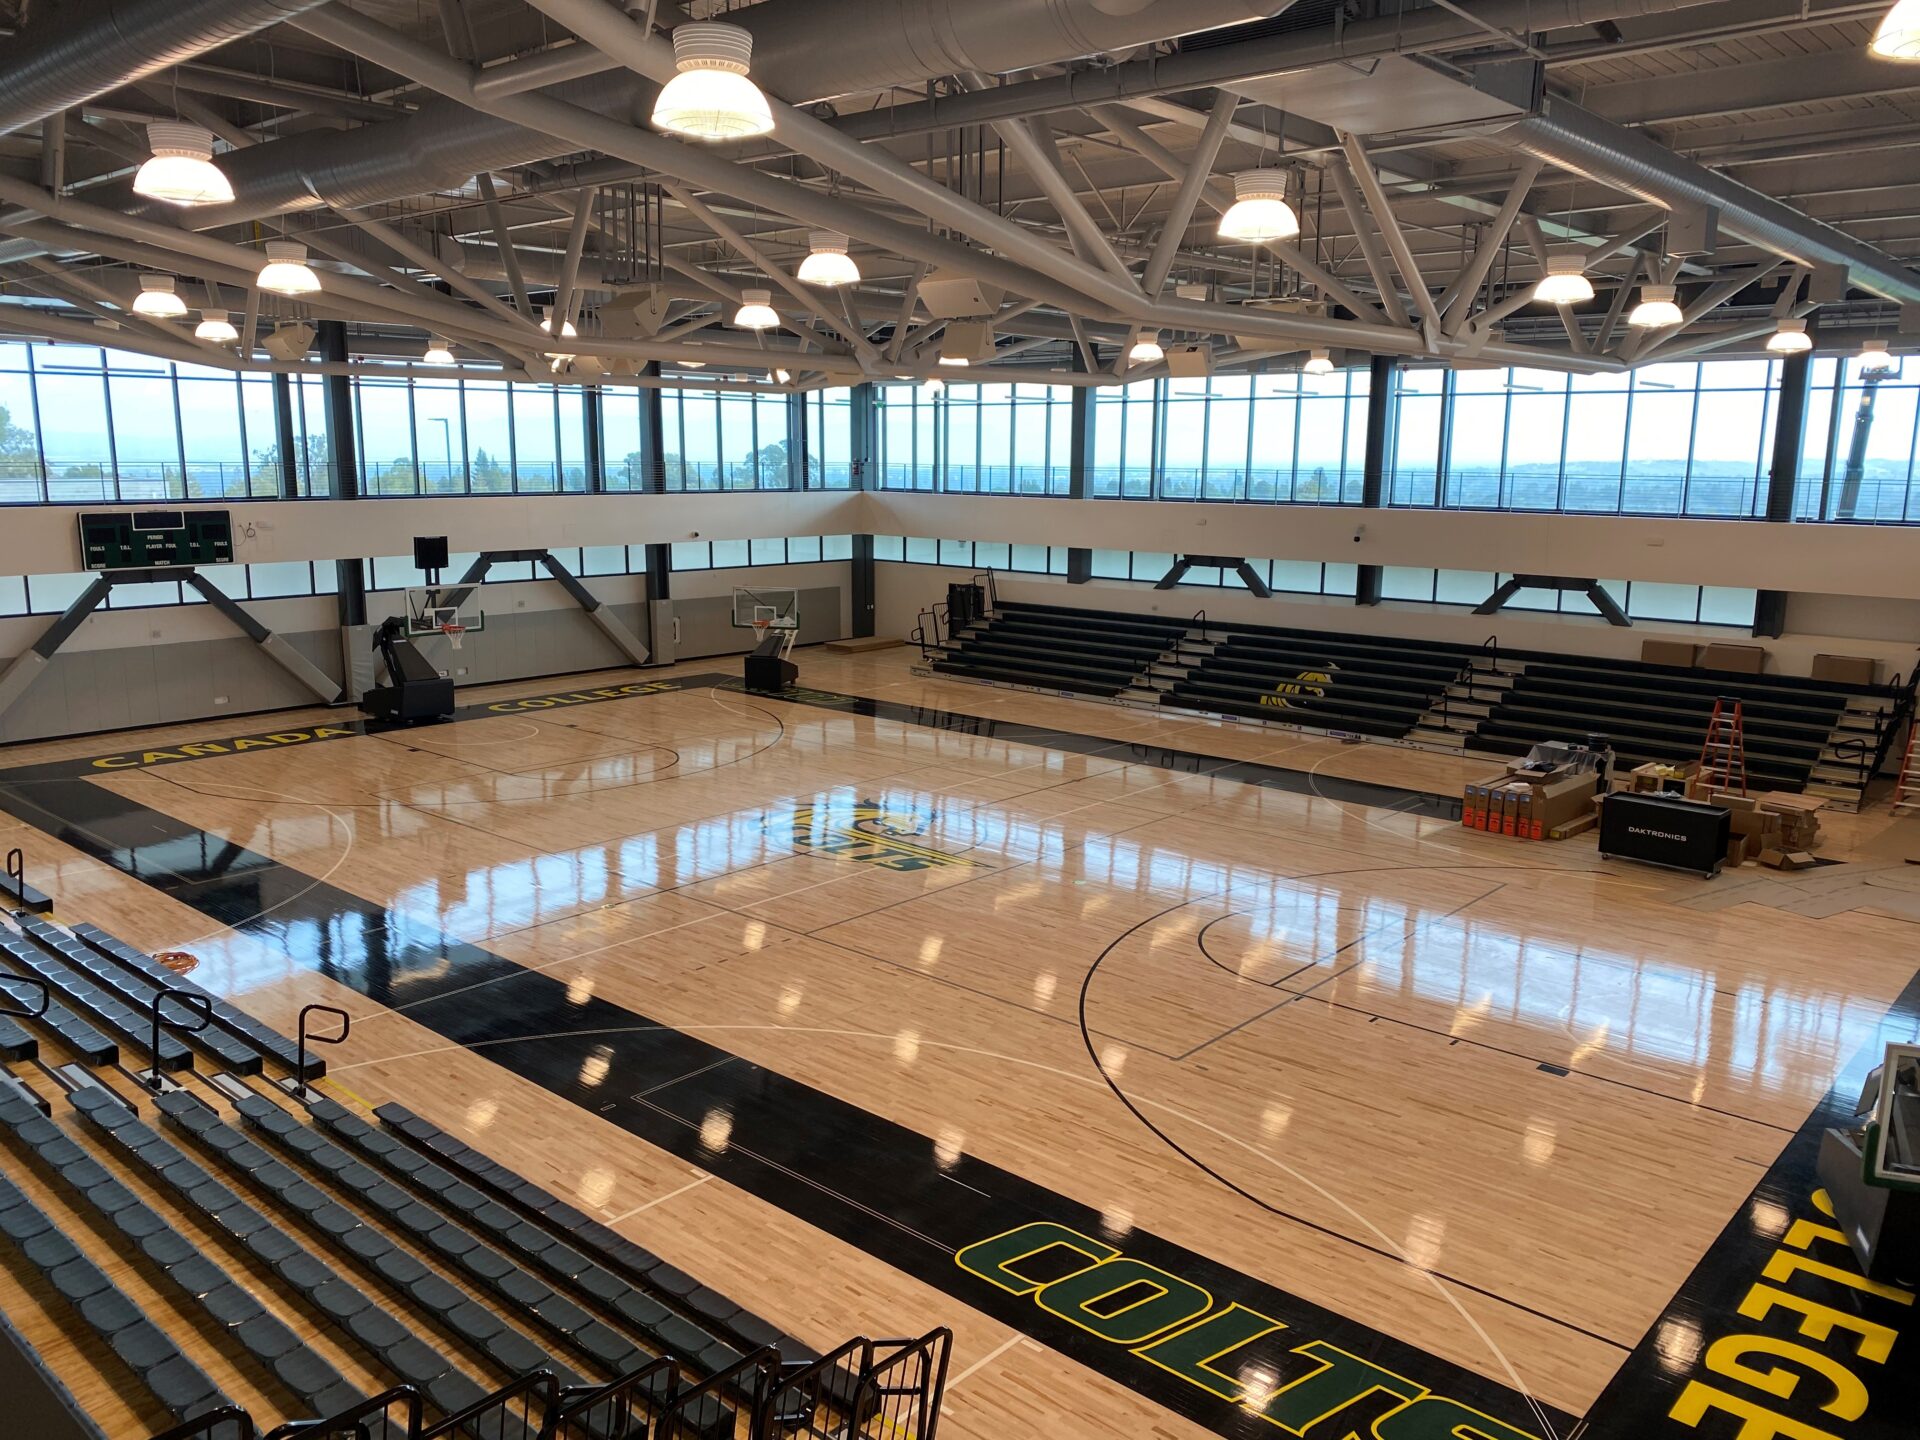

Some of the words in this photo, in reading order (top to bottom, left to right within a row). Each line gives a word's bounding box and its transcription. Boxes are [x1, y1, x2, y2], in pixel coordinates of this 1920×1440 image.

[486, 680, 682, 713] COLLEGE
[92, 721, 355, 770] CAÑADA
[1628, 826, 1688, 842] DAKTRONICS
